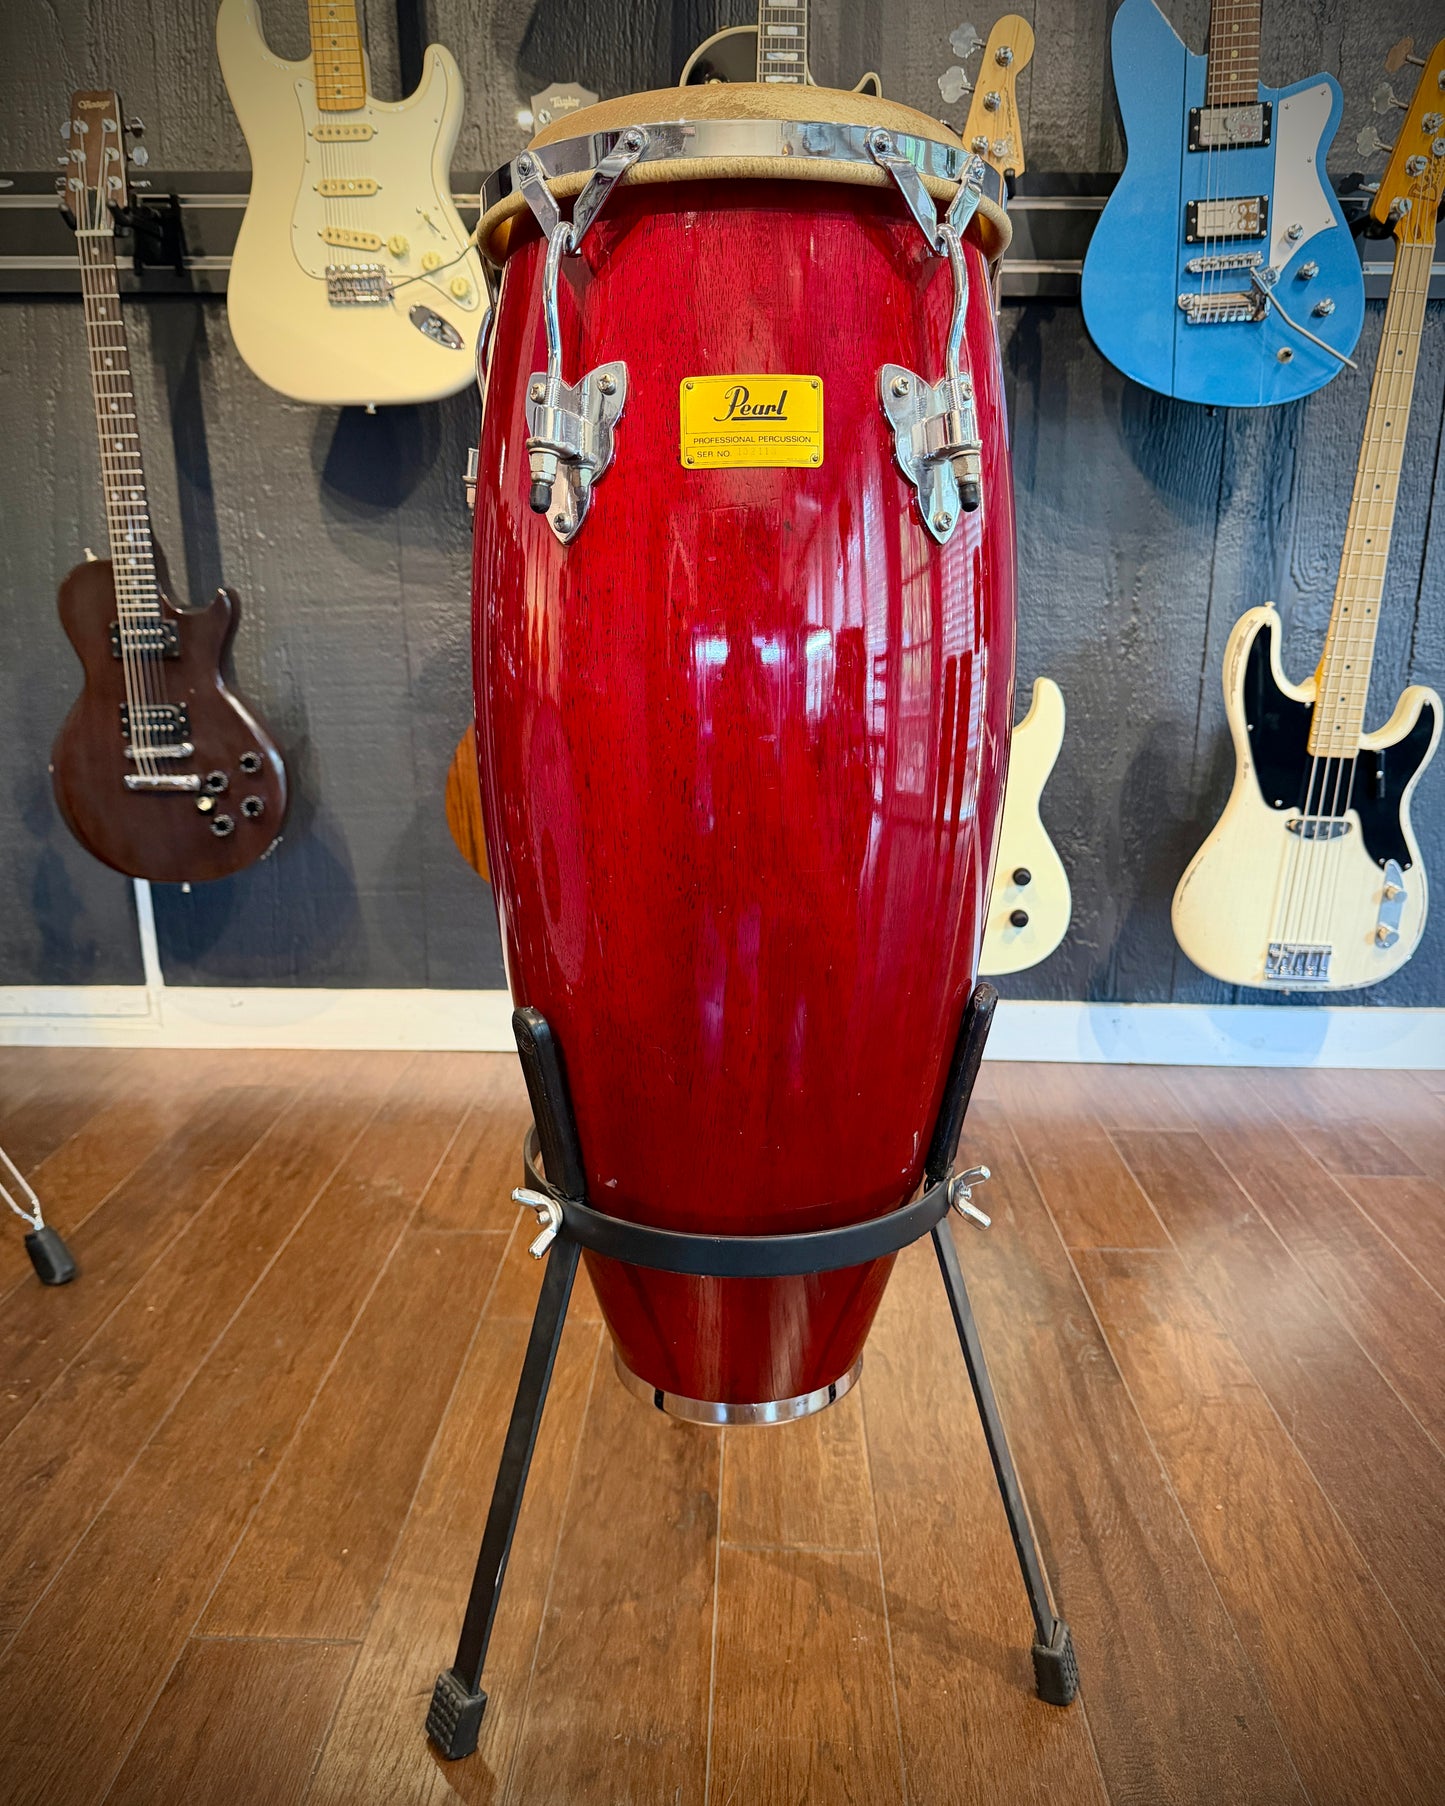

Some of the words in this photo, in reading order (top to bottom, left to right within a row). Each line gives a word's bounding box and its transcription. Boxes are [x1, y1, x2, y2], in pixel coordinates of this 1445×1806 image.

[713, 385, 788, 421] Pearl
[693, 436, 755, 444] PROFESSIONAL
[758, 435, 811, 443] PERCUSSION
[696, 450, 714, 458] SER
